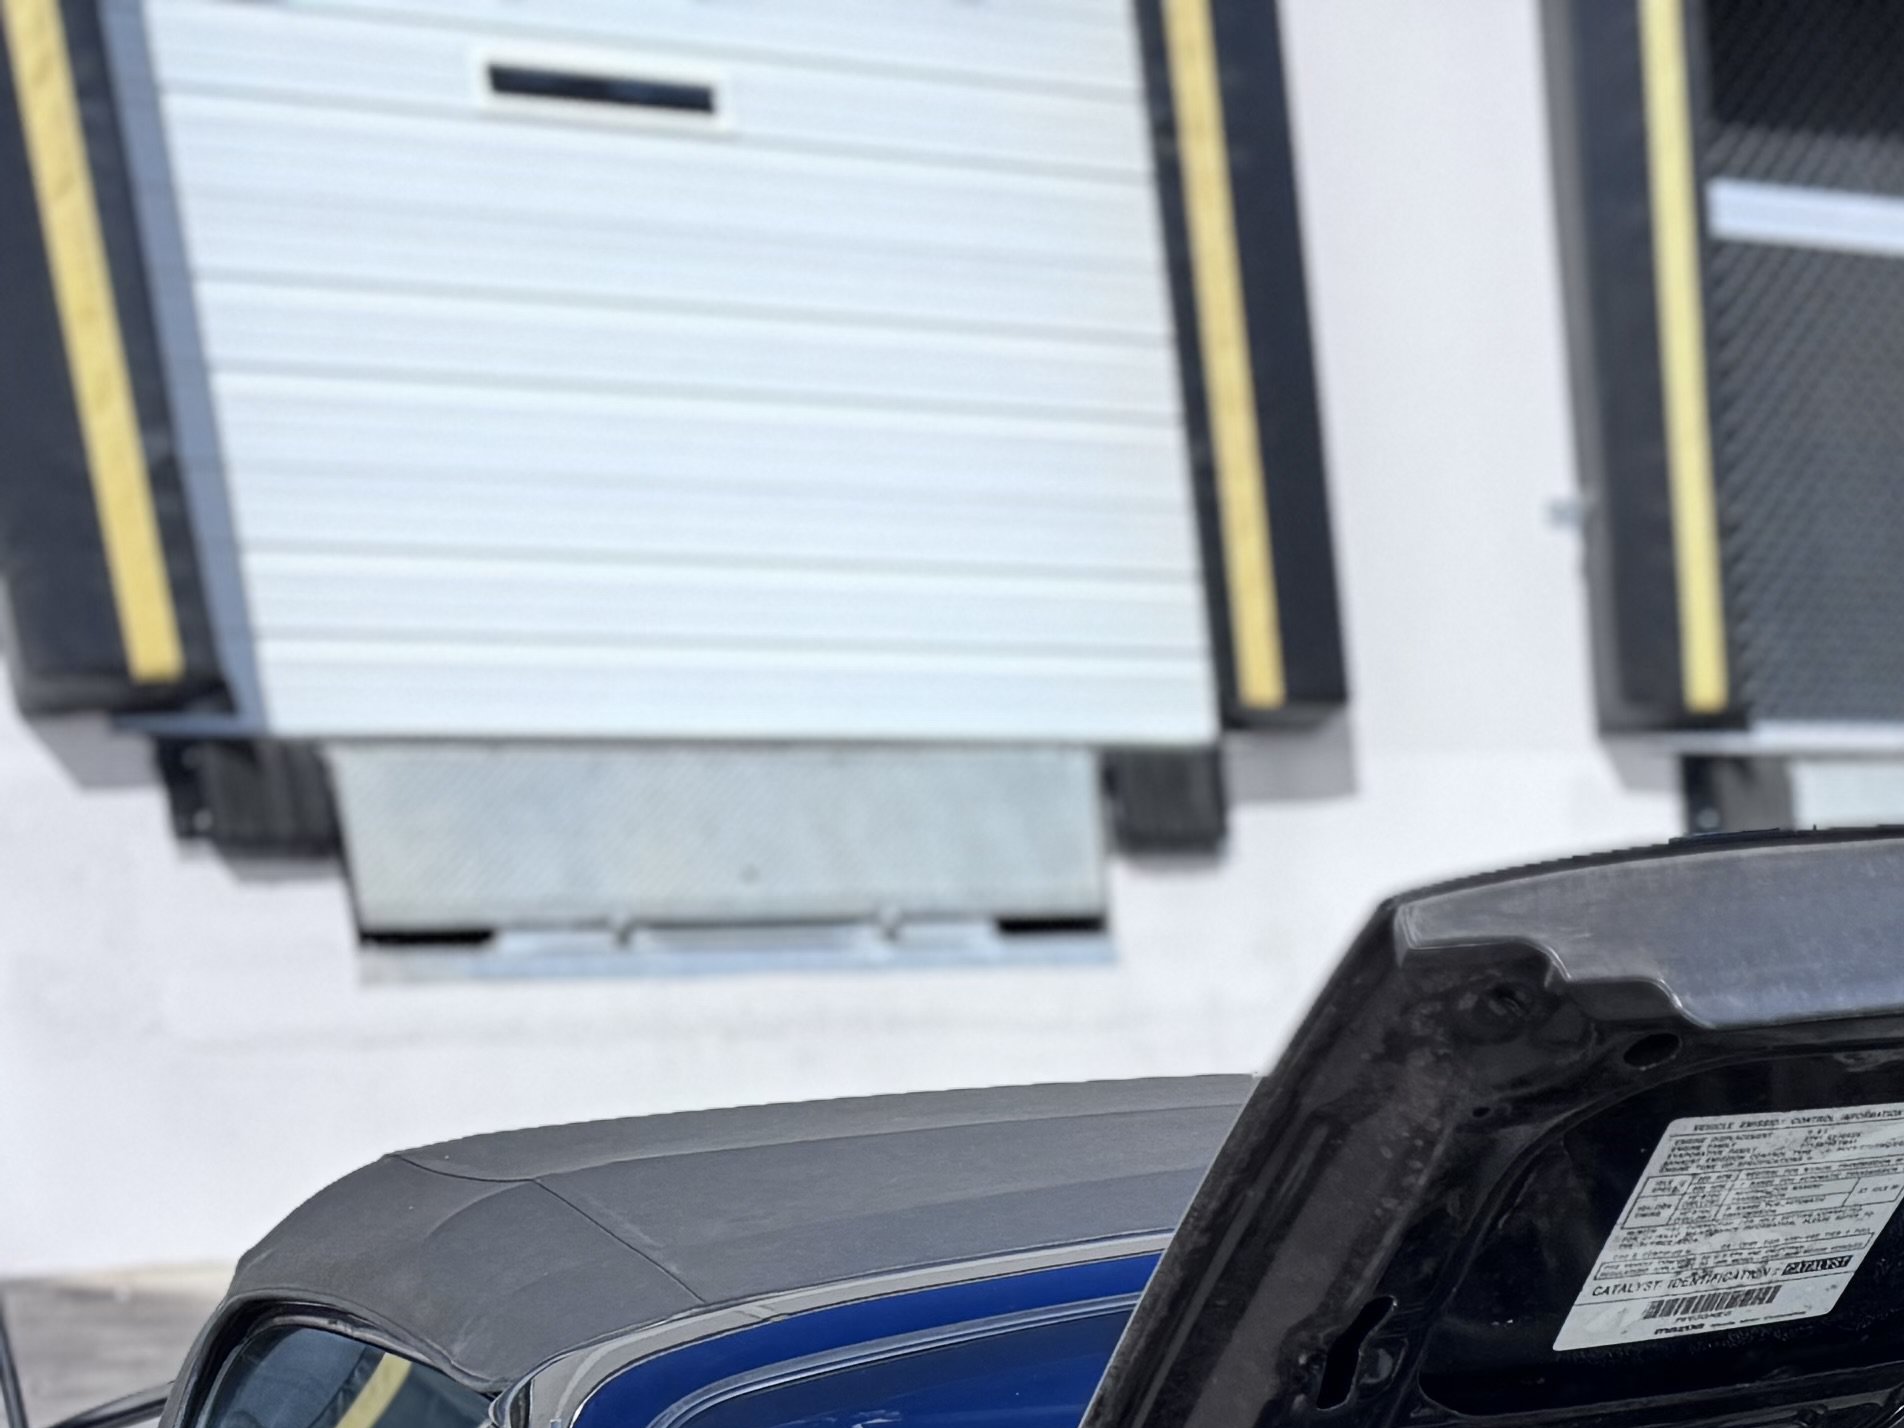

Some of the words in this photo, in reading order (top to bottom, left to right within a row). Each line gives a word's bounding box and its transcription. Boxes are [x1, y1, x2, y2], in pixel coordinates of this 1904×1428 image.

[1589, 1278, 1663, 1298] CATALYST
[1664, 1266, 1773, 1289] IDENTIFICATION
[1781, 1255, 1853, 1275] CATALYST
